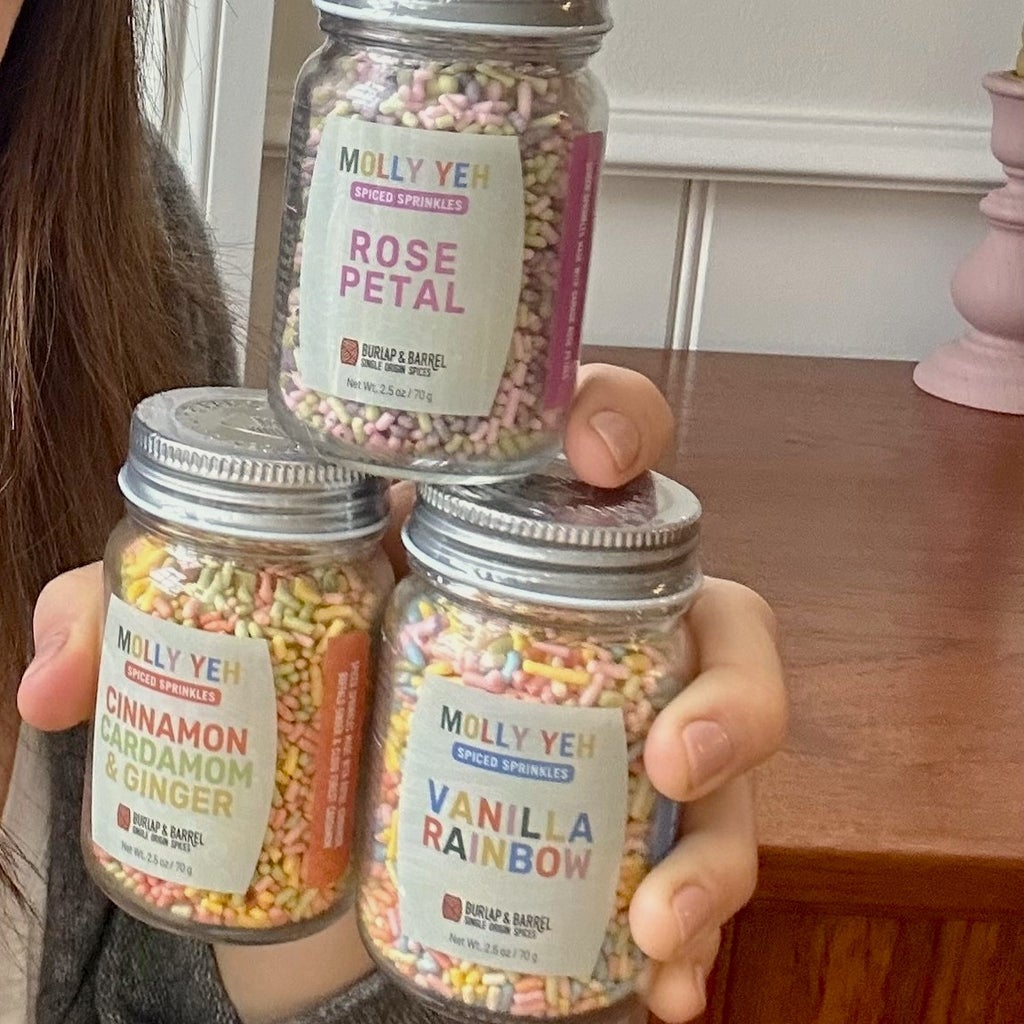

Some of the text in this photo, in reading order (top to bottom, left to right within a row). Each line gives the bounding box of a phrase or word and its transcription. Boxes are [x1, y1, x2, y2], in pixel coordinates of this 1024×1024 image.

[340, 146, 490, 189] MOLLY YEH
[354, 186, 463, 211] SPICED SPRINKLES
[350, 229, 458, 275] ROSE
[339, 265, 465, 314] PETAL
[362, 343, 447, 371] BURLAP & BARREL
[408, 366, 431, 377] SPICES
[347, 377, 361, 389] Net
[380, 384, 394, 396] 2.5
[396, 389, 407, 397] oz
[414, 389, 425, 400] 70
[117, 625, 241, 685] MOLLY YEH
[127, 665, 216, 702] SPICED SPRINKLES
[106, 685, 248, 755] CINNAMON
[440, 704, 595, 759] MOLLY YEH
[101, 714, 254, 788] CARDAMOM
[457, 747, 569, 779] SPICED SPRINKLES
[105, 751, 233, 817] & GINGER
[132, 811, 205, 847] BURLAP & BARREL
[428, 778, 593, 844] VANILLA
[422, 814, 592, 879] RAINBOW
[465, 901, 552, 933] BURLAP & BARREL
